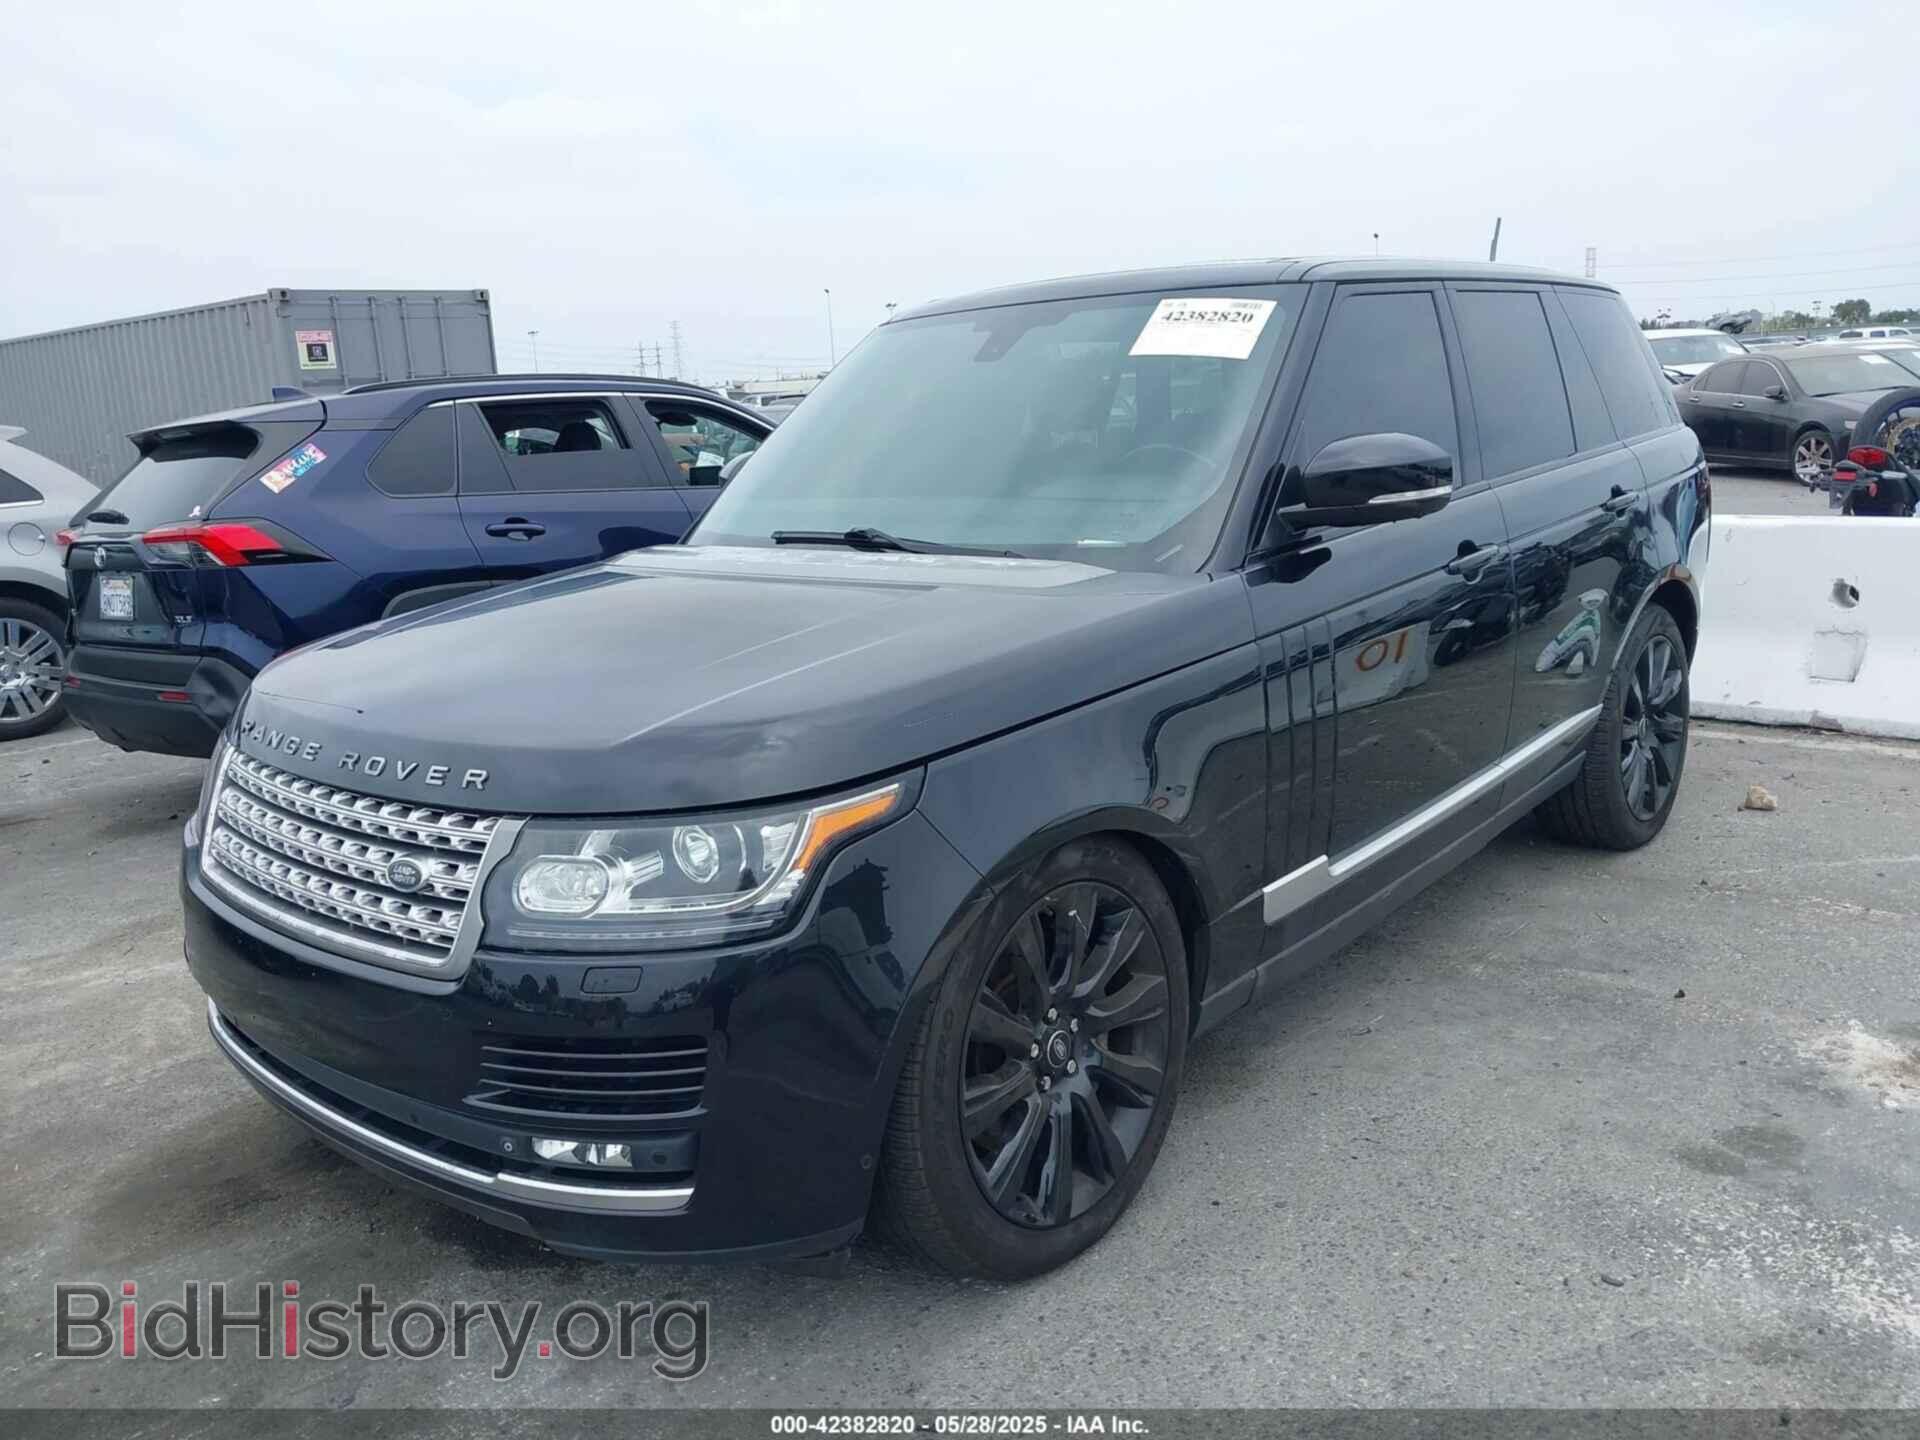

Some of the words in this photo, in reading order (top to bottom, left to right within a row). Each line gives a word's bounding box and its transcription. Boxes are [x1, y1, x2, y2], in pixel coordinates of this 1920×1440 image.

[1161, 310, 1254, 323] 42382820
[241, 720, 321, 761] RANGE
[338, 752, 488, 790] ROVER
